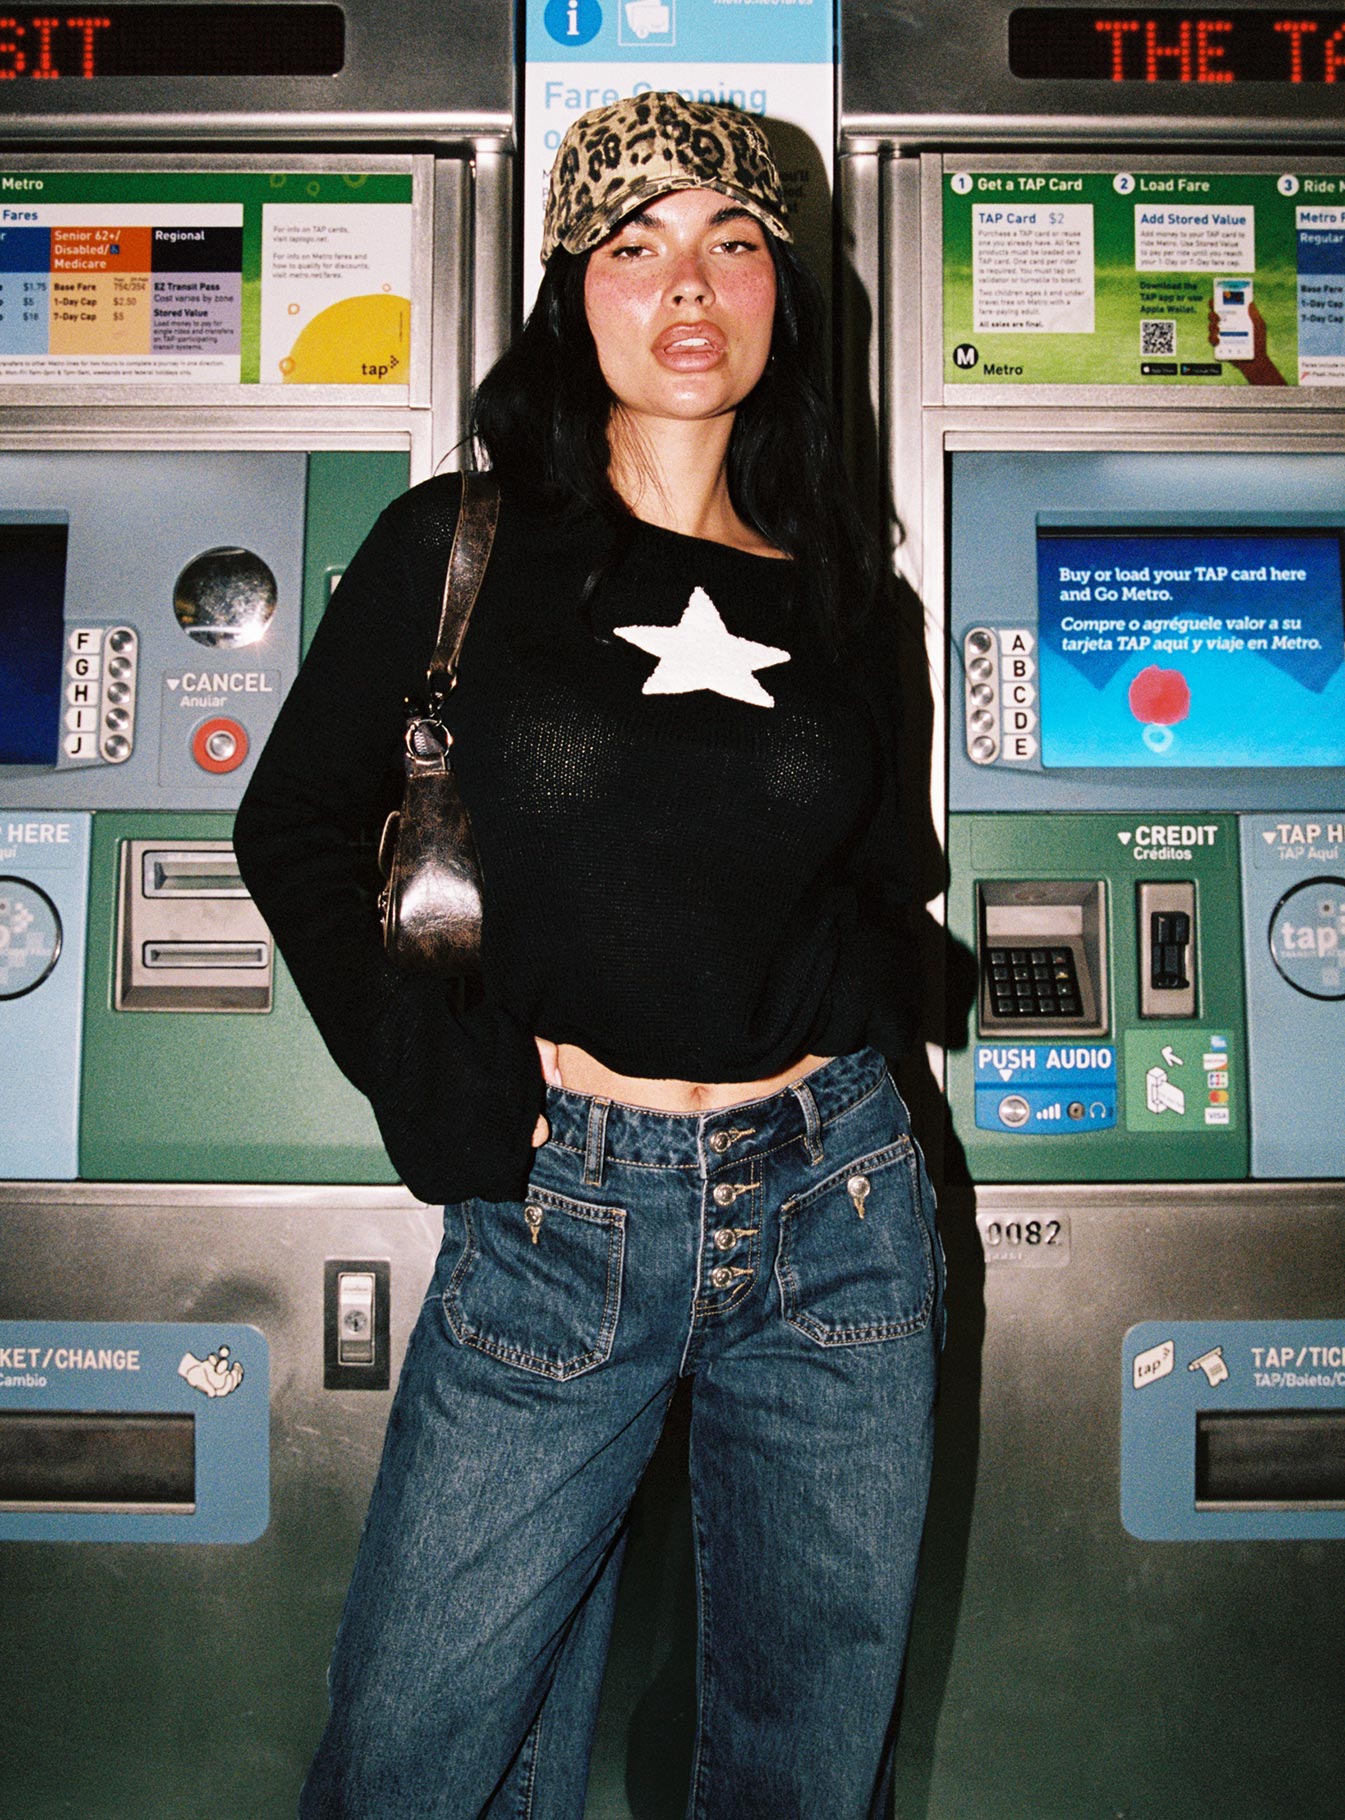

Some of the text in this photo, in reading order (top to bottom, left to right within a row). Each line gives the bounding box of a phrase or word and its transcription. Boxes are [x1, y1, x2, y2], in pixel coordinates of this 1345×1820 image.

[1095, 21, 1233, 82] THE
[544, 82, 620, 109] Fare
[2, 178, 44, 190] Metro
[958, 178, 965, 189] 1
[978, 178, 1083, 190] Get a TAP Card
[1121, 178, 1128, 189] 2
[1140, 179, 1210, 191] Load Fare
[1284, 179, 1293, 191] 3
[1304, 180, 1335, 192] Ride
[3, 210, 38, 221] Fares
[979, 212, 1064, 224] TAP Card $2
[1141, 213, 1246, 225] Add Stored Value
[1300, 212, 1337, 223] Metro
[54, 230, 121, 241] Senior 62+/
[155, 230, 205, 242] Regional
[1300, 232, 1345, 245] Regular
[54, 244, 110, 255] Disabled/
[54, 259, 107, 269] Medicare
[54, 283, 96, 291] Base Fare
[167, 282, 198, 291] Transit
[200, 282, 220, 291] Pass
[1301, 284, 1343, 293] Base Fare
[54, 297, 97, 307] 1-Day Cap
[153, 294, 173, 303] Cost
[214, 295, 234, 303] zone
[1328, 299, 1344, 309] Cap
[54, 312, 97, 322] 7-Day Cap
[153, 308, 208, 317] Stored Value
[362, 363, 388, 378] tap
[984, 364, 1023, 375] Metro
[1059, 567, 1307, 585] Buy or load your TAP card here
[1059, 587, 1173, 601] and Go Metro.
[1061, 616, 1301, 635] Compre o agréguele valor a su
[77, 633, 90, 649] F
[1012, 636, 1025, 651] A
[1062, 636, 1323, 655] tarjeta TAP aquí y viaje en Metro.
[76, 659, 89, 675] G
[1014, 661, 1026, 677] B
[182, 673, 273, 692] CANCEL
[75, 685, 88, 701] H
[1013, 687, 1026, 703] C
[180, 696, 228, 707] Anular
[1015, 713, 1028, 729] D
[71, 737, 81, 754] J
[1016, 739, 1027, 755] E
[8, 824, 71, 843] HERE
[1136, 826, 1218, 846] CREDIT
[1277, 824, 1345, 844] TAP H
[1133, 846, 1193, 861] Créditos
[1278, 847, 1305, 860] TAP
[1282, 922, 1338, 958] tap
[978, 1049, 1112, 1069] PUSH AUDIO
[987, 1220, 1061, 1246] 0082
[1250, 1347, 1345, 1368] TAP/TIC
[1137, 1354, 1162, 1378] tap
